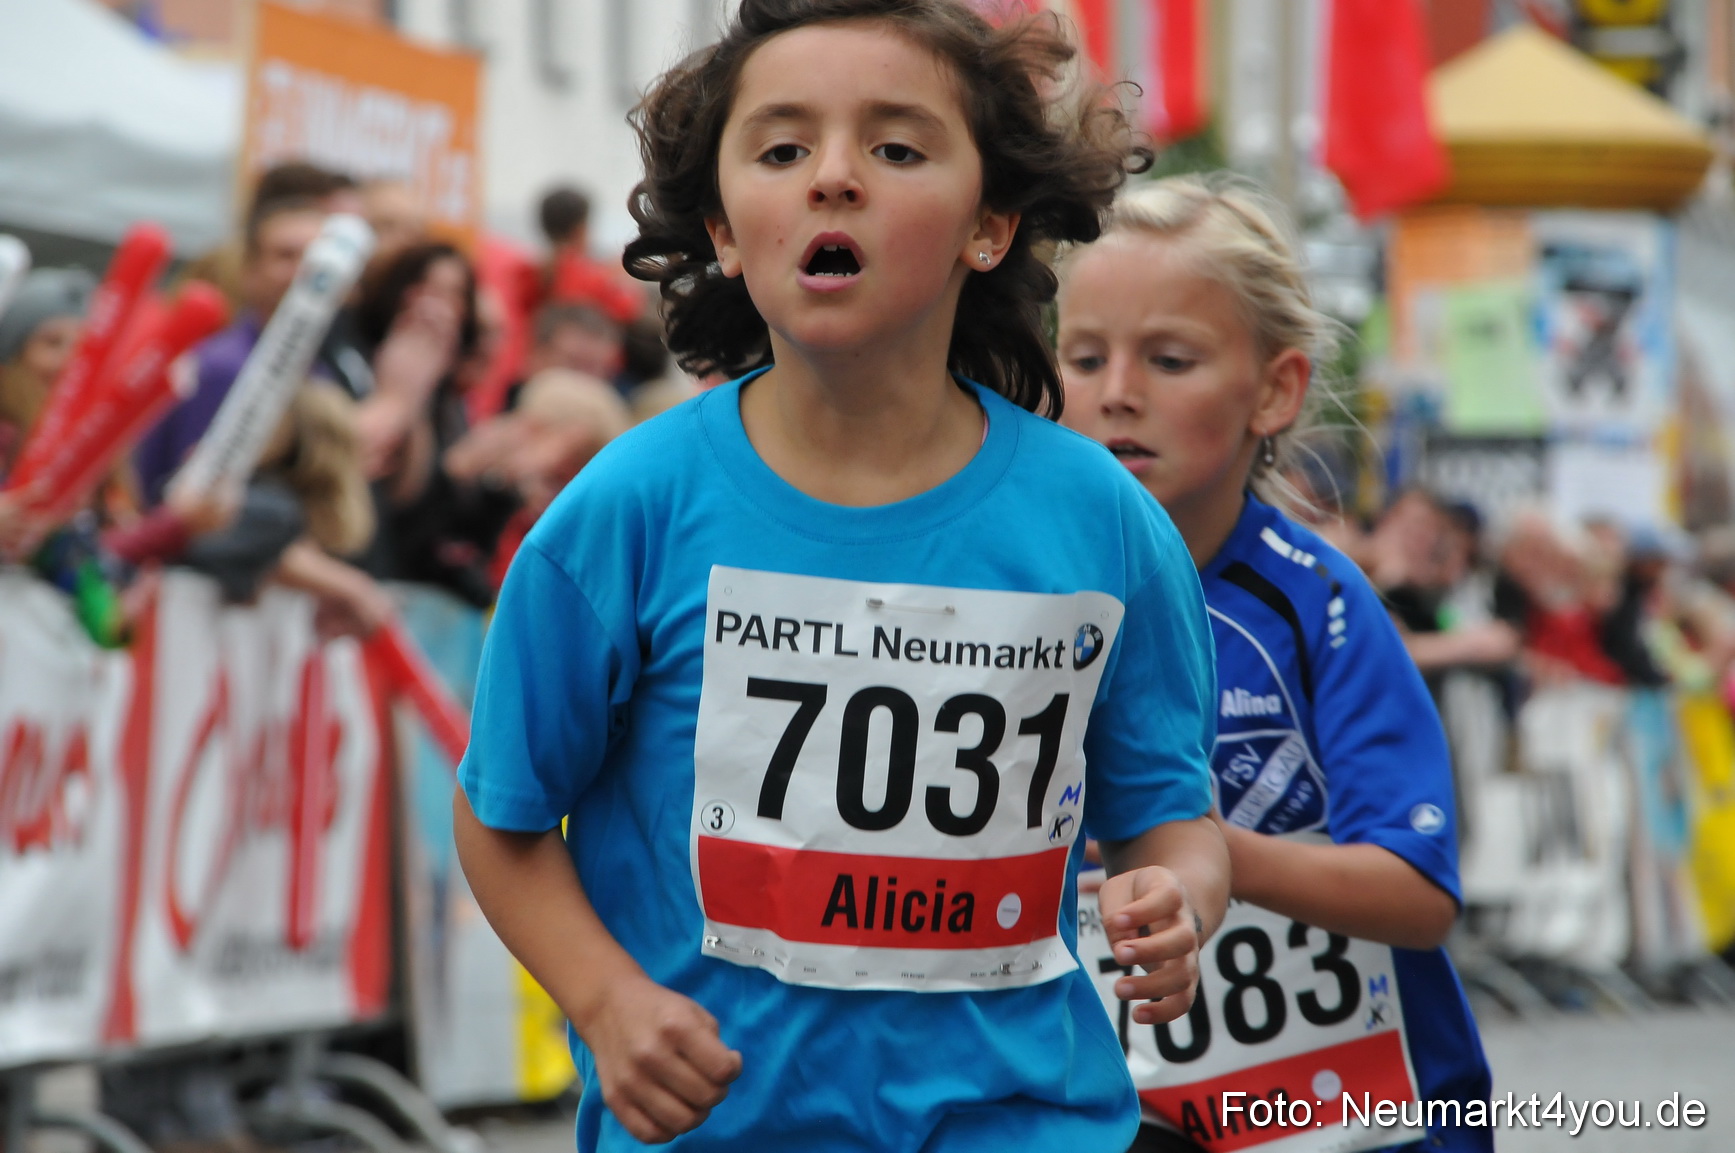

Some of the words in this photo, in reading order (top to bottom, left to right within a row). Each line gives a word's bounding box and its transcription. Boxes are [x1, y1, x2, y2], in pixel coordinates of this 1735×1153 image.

[715, 610, 859, 657] PARTL
[871, 626, 1066, 669] Neumarkt
[1220, 687, 1282, 718] Alina
[746, 676, 1070, 837] 7031
[1220, 742, 1263, 790] FSV
[711, 806, 724, 829] 3
[1059, 781, 1082, 806] M
[821, 873, 975, 932] Alicia
